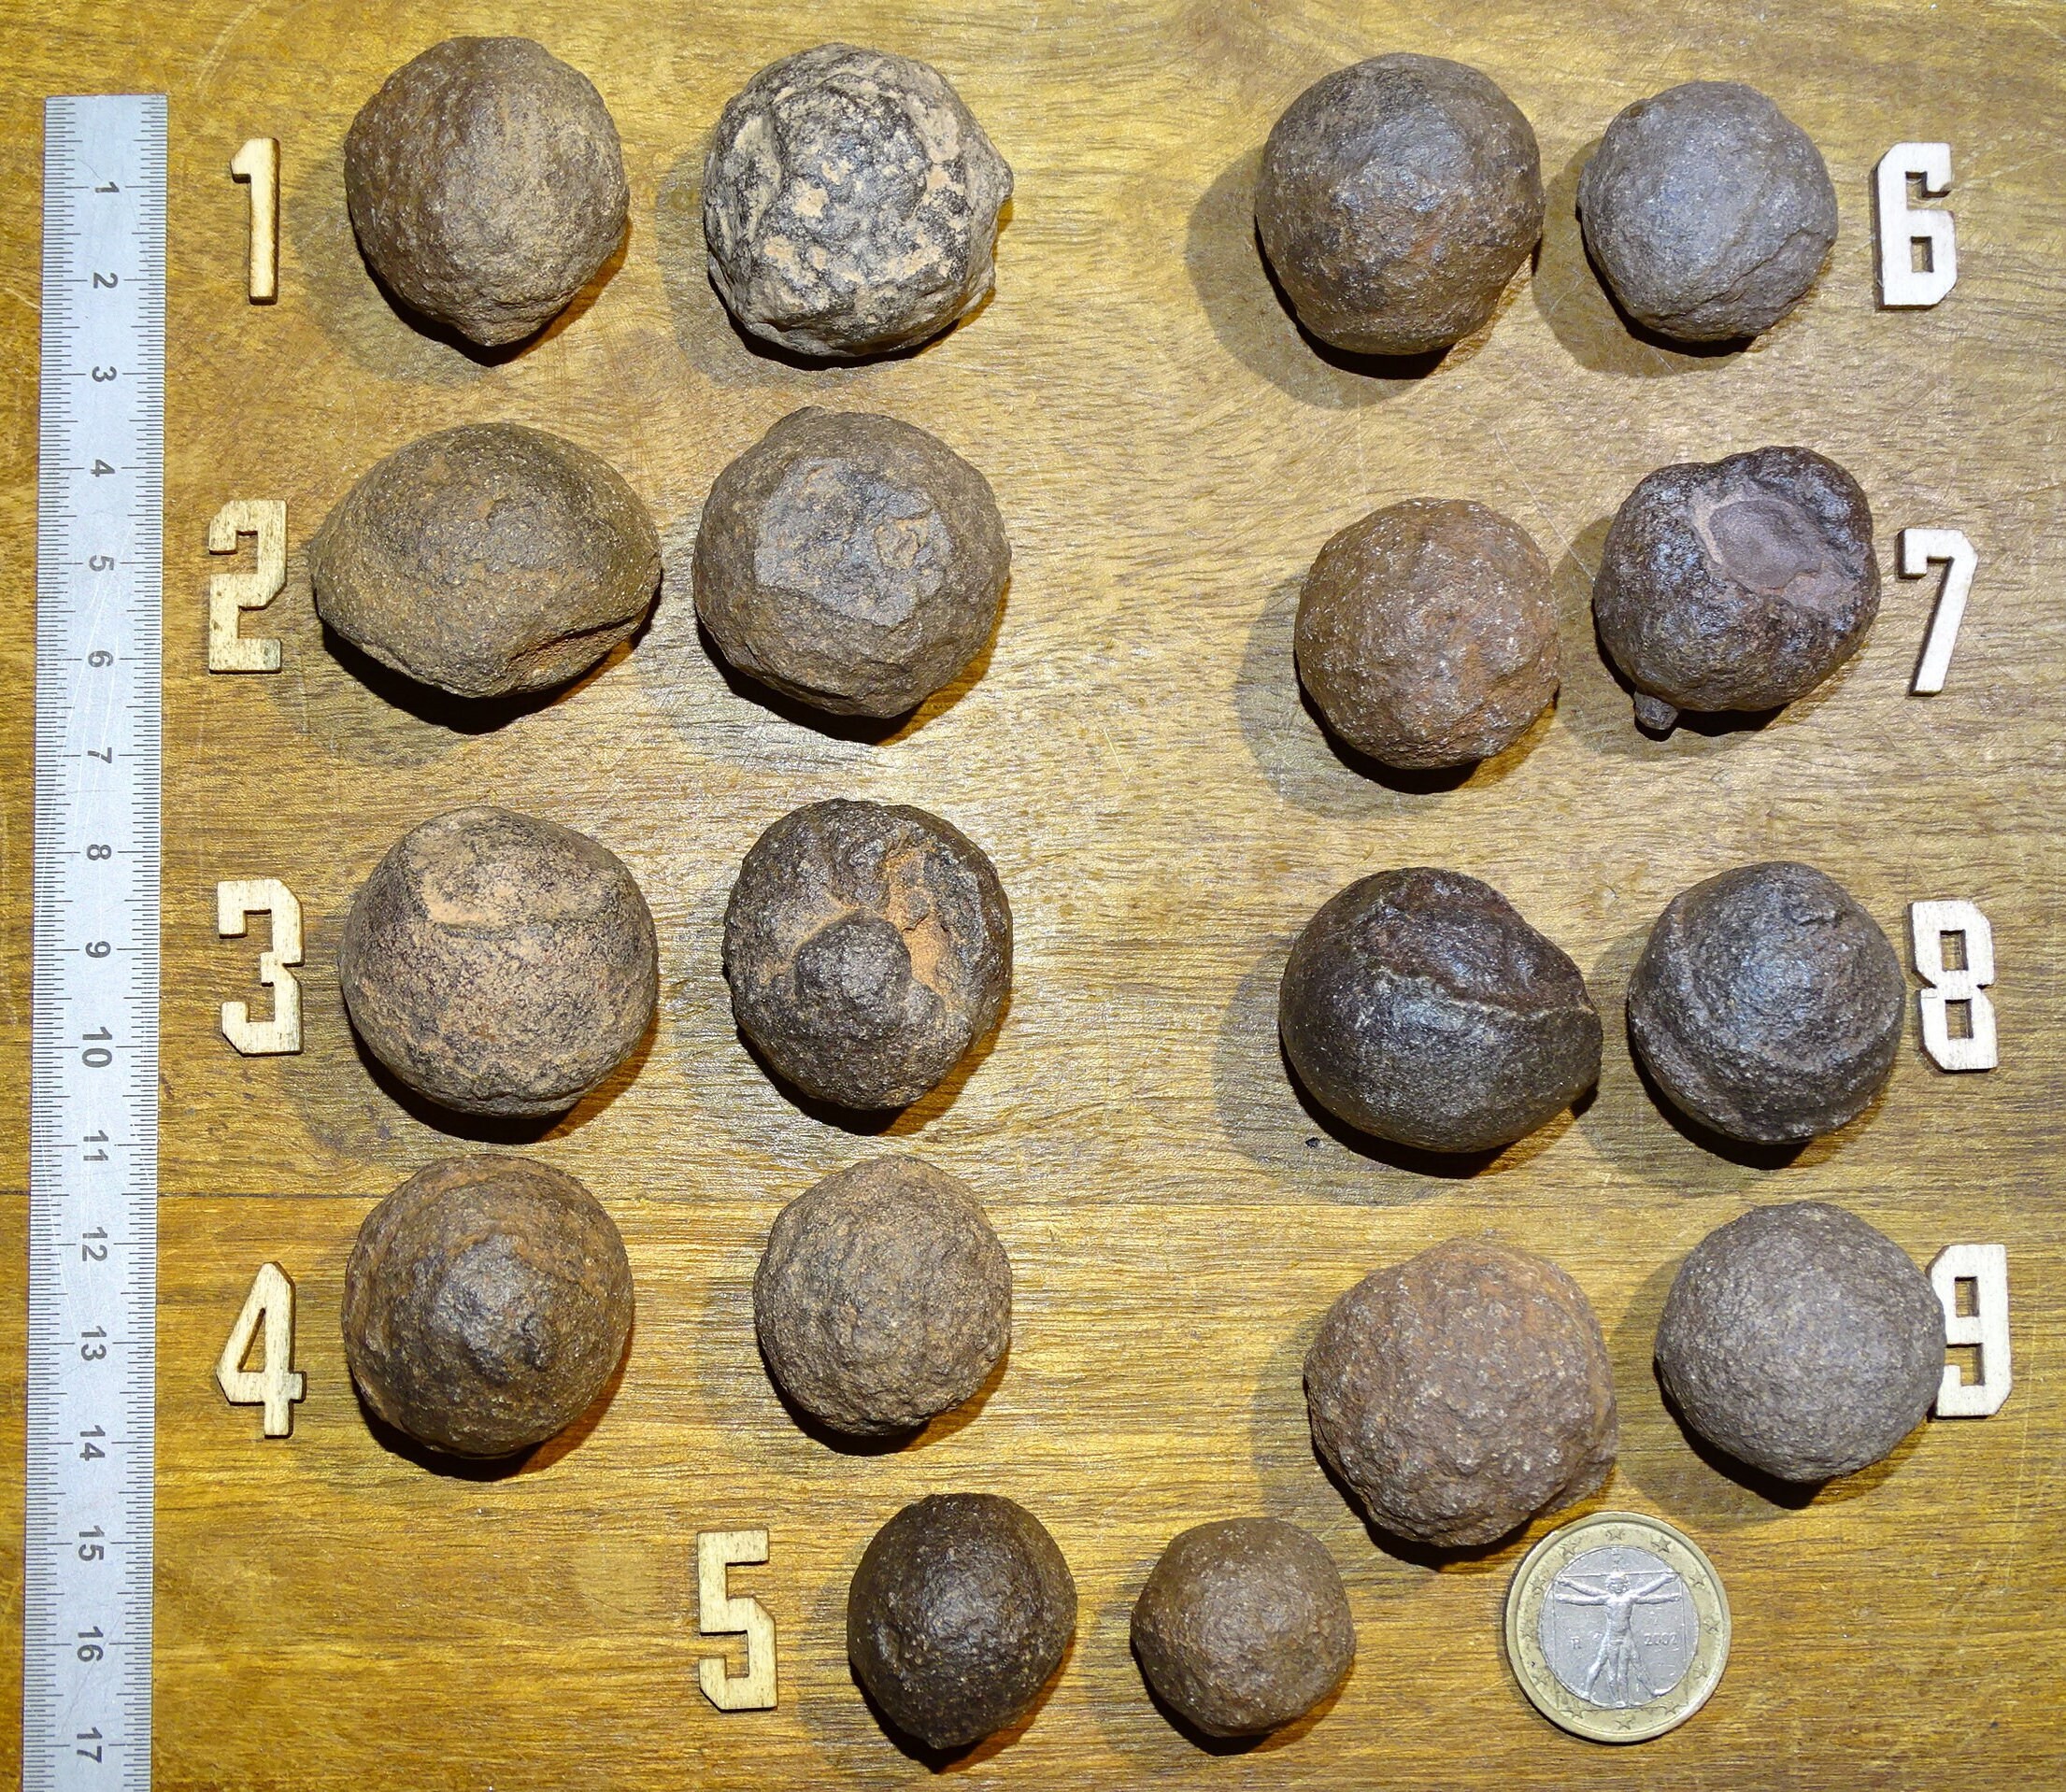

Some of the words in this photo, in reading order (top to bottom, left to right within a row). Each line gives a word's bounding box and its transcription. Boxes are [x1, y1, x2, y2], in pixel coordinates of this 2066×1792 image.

[95, 181, 119, 193] 1
[231, 138, 278, 303] 1
[1876, 140, 1958, 305] 6
[93, 273, 118, 288] 2
[93, 366, 116, 382] 3
[92, 460, 114, 476] 4
[90, 556, 114, 571] 5
[208, 499, 287, 671] 2
[1898, 527, 1978, 695] 7
[89, 651, 112, 667] 6
[88, 747, 111, 763] 7
[87, 845, 111, 860] 8
[86, 942, 110, 958] 9
[217, 879, 301, 1053] 3
[1912, 897, 1994, 1070] 8
[82, 1027, 112, 1067] 10
[84, 1131, 108, 1160] 11
[82, 1227, 107, 1261] 12
[81, 1327, 107, 1360] 13
[1930, 1244, 2011, 1415] 9
[217, 1261, 305, 1436] 4
[80, 1426, 105, 1460] 14
[78, 1526, 104, 1560] 15
[697, 1530, 777, 1710] 5
[78, 1627, 103, 1661] 16
[77, 1728, 102, 1763] 17
